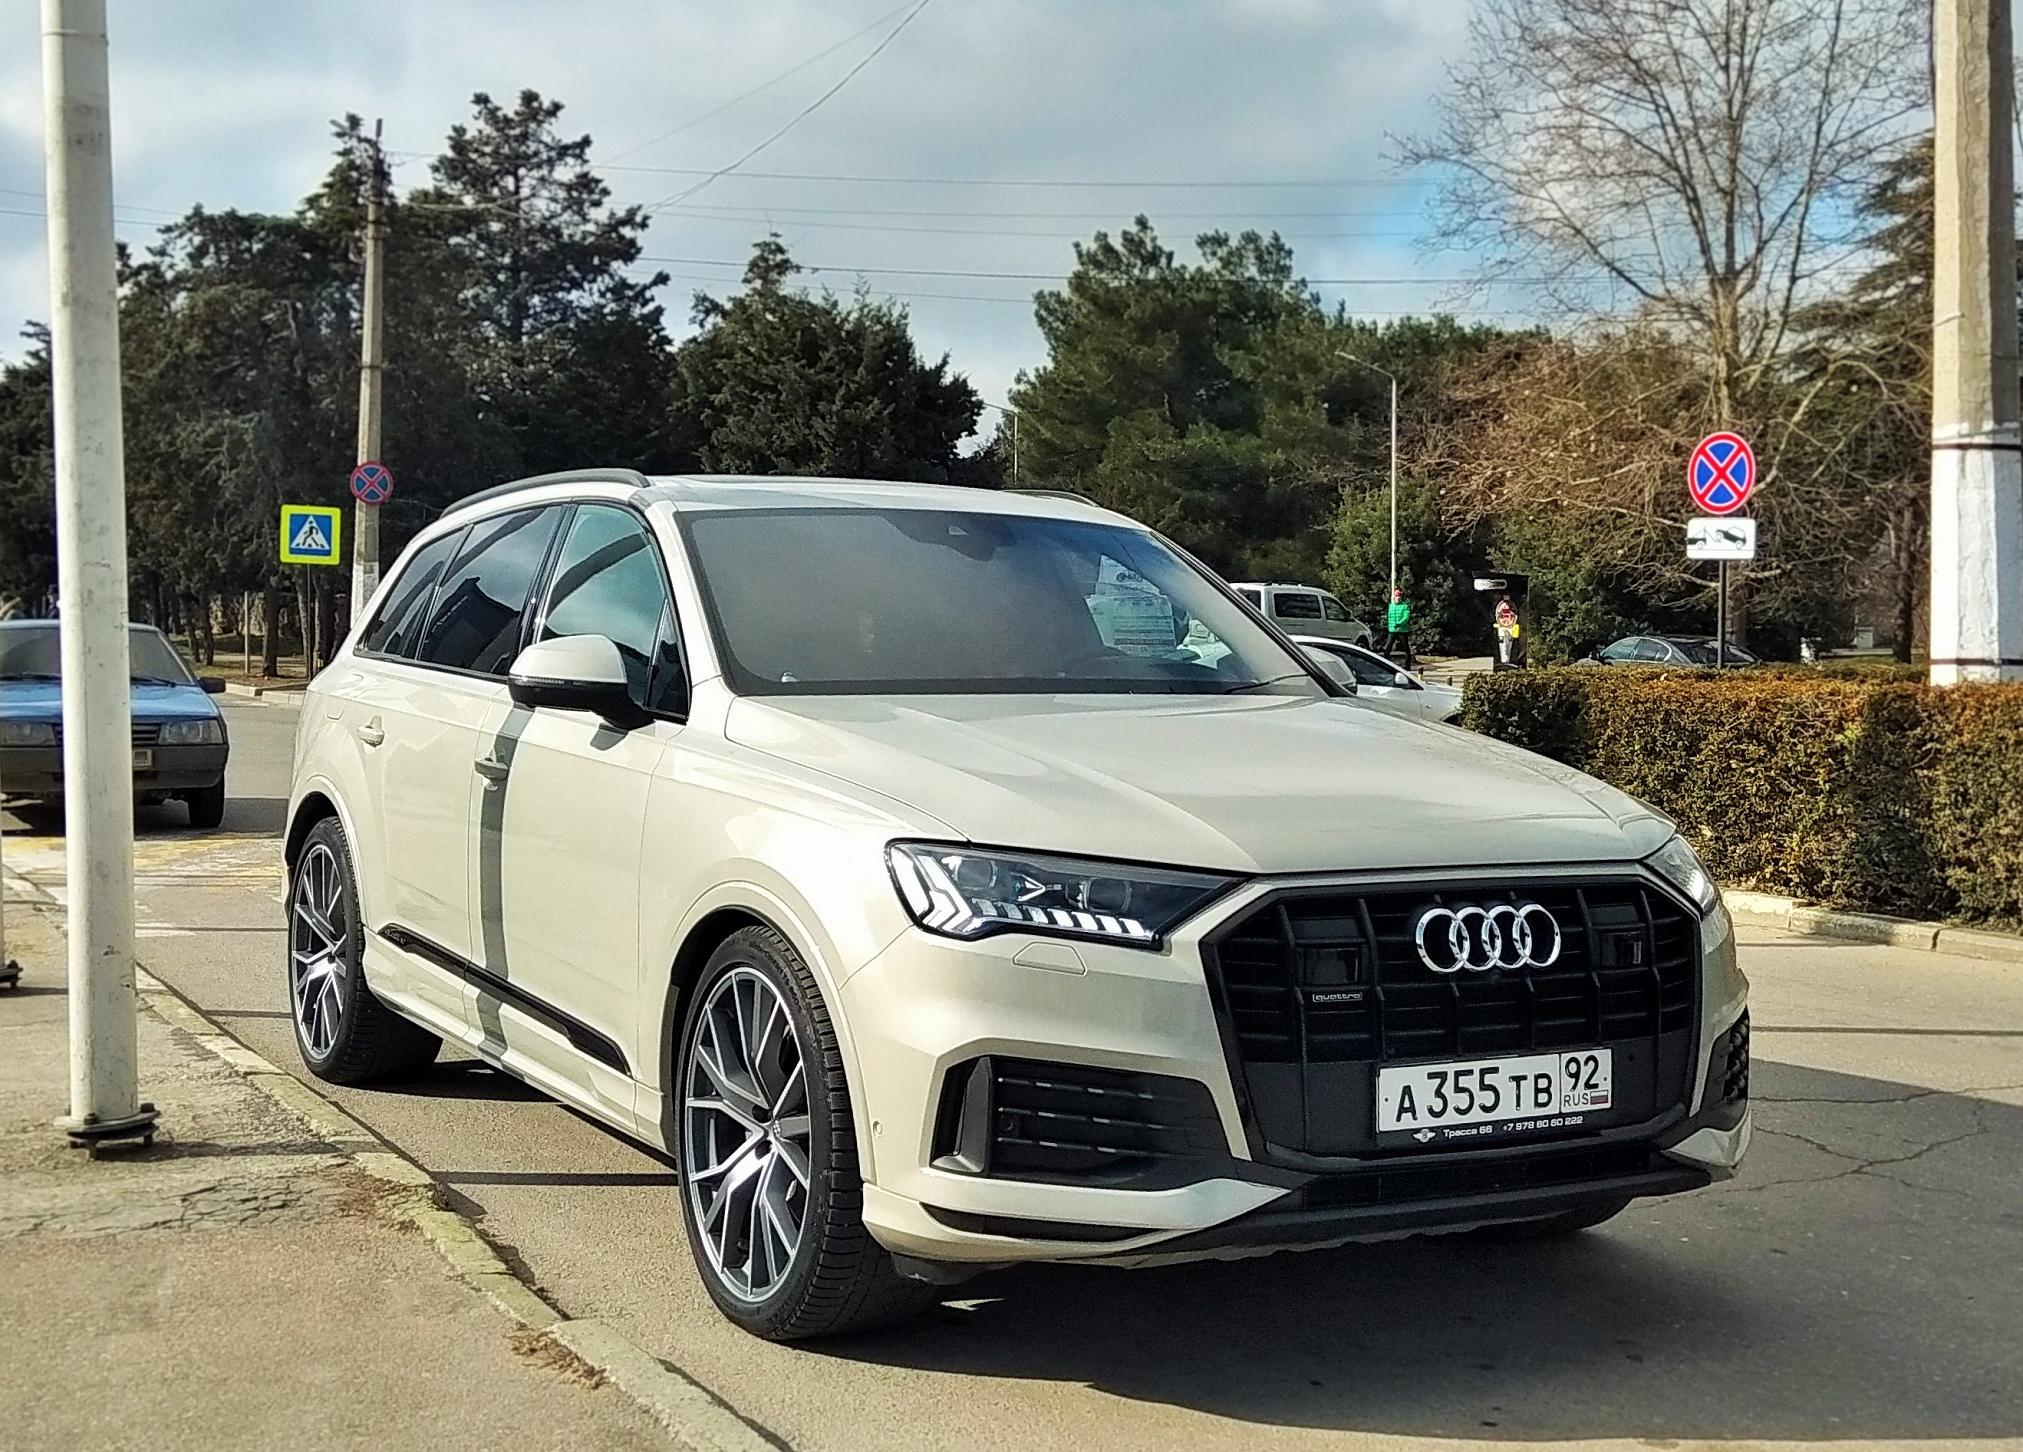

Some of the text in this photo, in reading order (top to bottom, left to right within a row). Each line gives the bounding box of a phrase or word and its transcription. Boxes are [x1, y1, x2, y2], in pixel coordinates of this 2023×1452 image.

[1315, 993, 1361, 1002] quattro
[1564, 1054, 1599, 1092] 92
[1426, 1067, 1500, 1119] 355
[1563, 1092, 1589, 1107] RUS
[1502, 1122, 1514, 1132] +7
[1515, 1121, 1535, 1131] 978
[1565, 1115, 1583, 1125] 222
